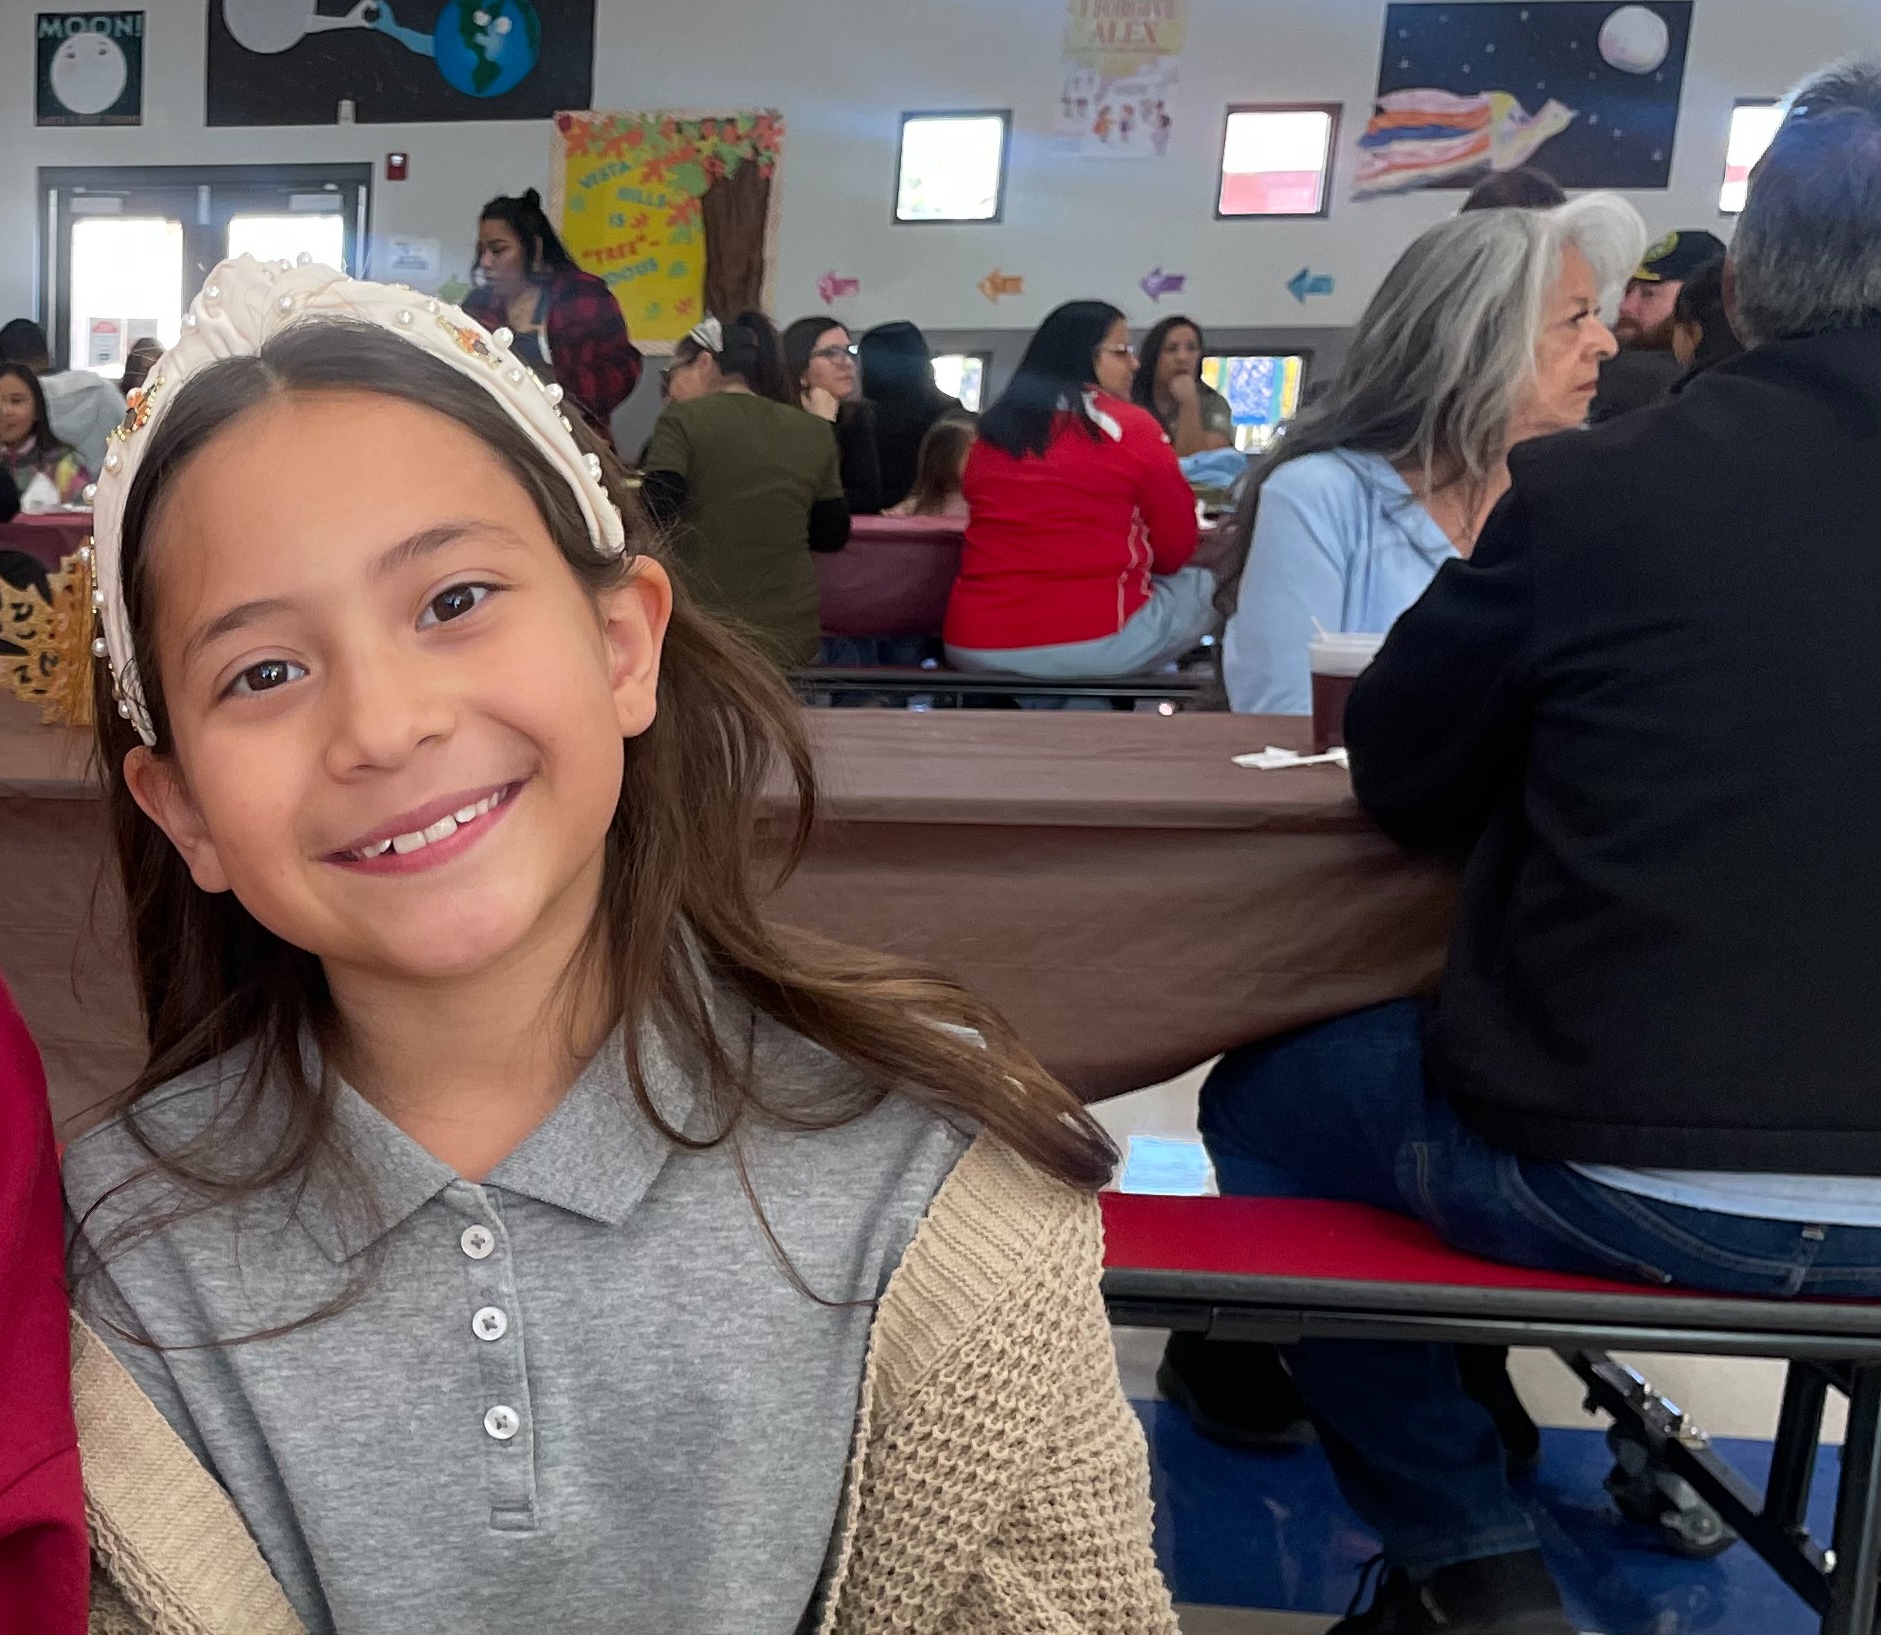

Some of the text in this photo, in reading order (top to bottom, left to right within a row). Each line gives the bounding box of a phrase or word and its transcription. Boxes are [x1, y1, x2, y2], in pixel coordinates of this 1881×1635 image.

[39, 15, 143, 39] MOON!
[1087, 20, 1157, 44] ALEX
[578, 161, 632, 188] VESTA
[616, 186, 667, 209] HILLS
[608, 212, 627, 230] IS
